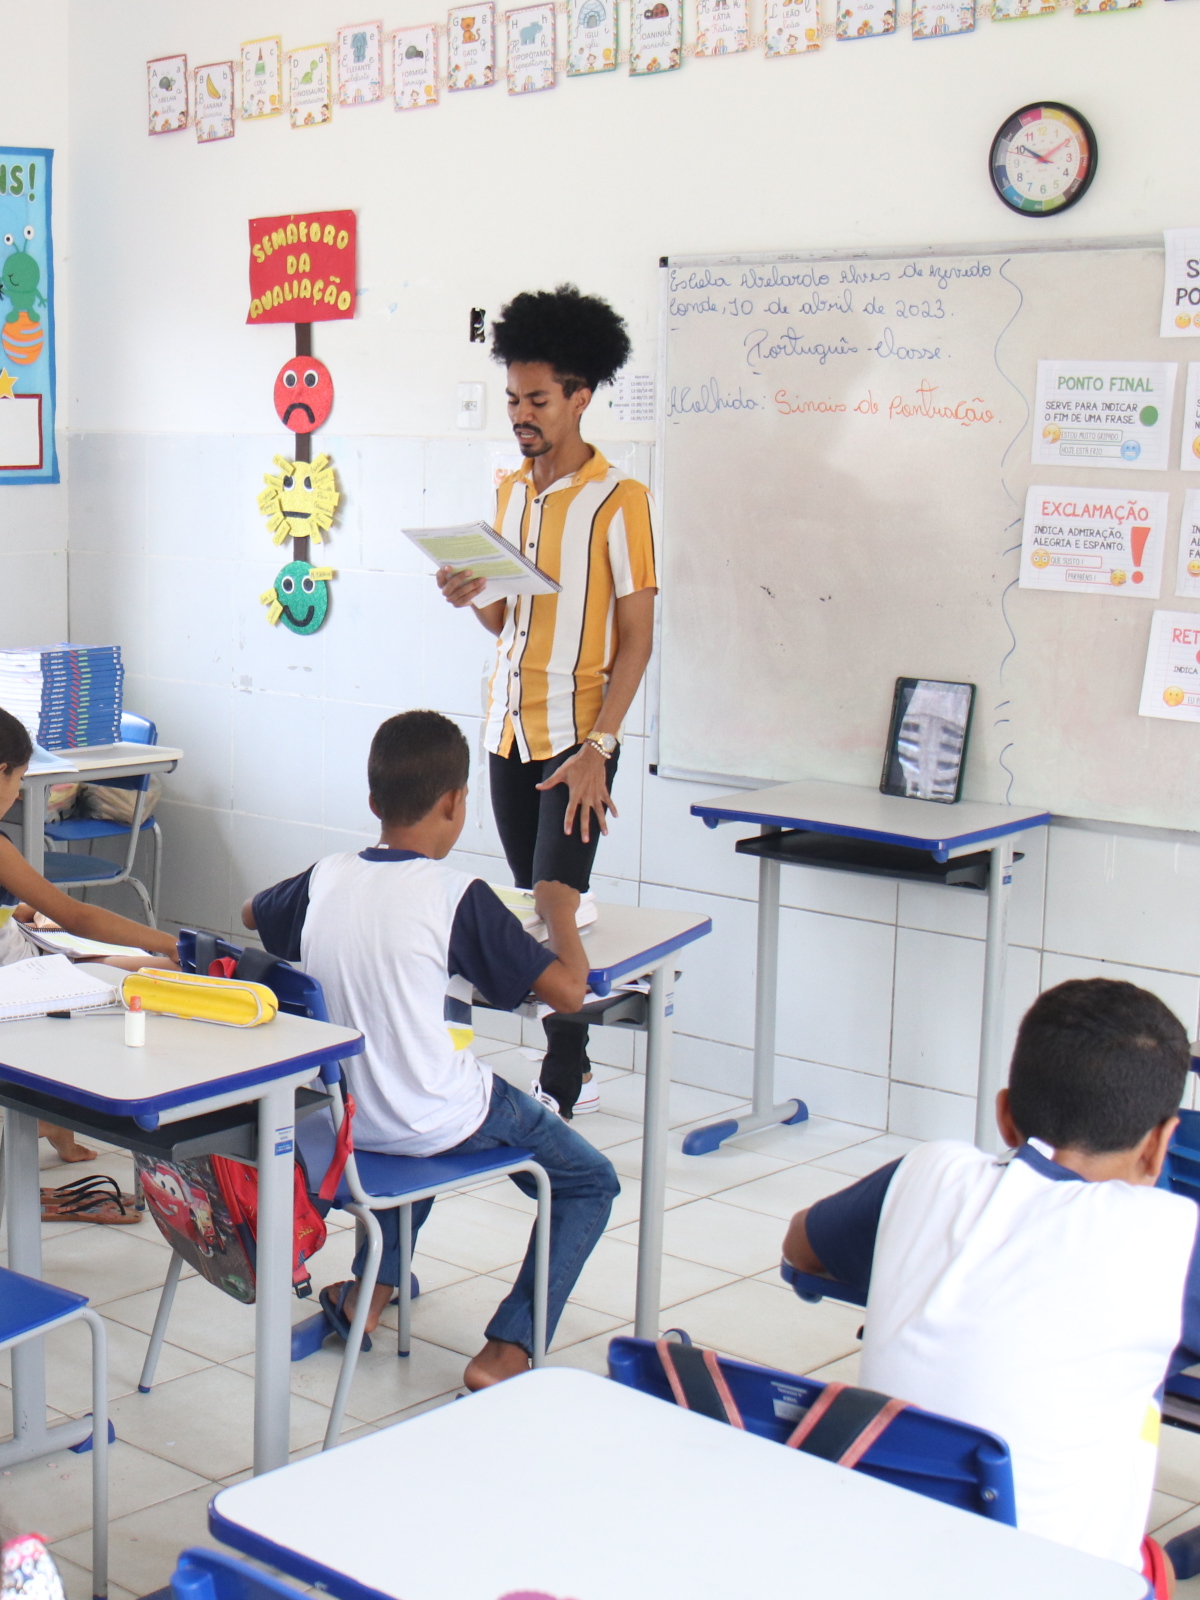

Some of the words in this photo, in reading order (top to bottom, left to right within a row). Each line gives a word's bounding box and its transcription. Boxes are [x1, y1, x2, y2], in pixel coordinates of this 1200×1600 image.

[712, 12, 731, 21] KÁTIA
[782, 9, 800, 19] LEÃO
[452, 17, 459, 27] G
[481, 15, 487, 25] g
[511, 20, 518, 30] H
[541, 14, 548, 24] h
[342, 36, 348, 45] E
[369, 33, 375, 41] e
[584, 31, 599, 39] IGLU
[639, 31, 672, 41] JOANINHA
[397, 39, 402, 49] F
[425, 33, 429, 43] f
[479, 39, 487, 51] g
[540, 34, 548, 48] h
[245, 52, 251, 60] C
[269, 48, 275, 56] c
[462, 49, 478, 57] GATO
[511, 49, 551, 61] HIPOPÓTAMO
[293, 59, 299, 69] D
[318, 53, 324, 64] d
[152, 70, 158, 78] A
[176, 66, 181, 74] a
[346, 64, 371, 74] ELEFANTE
[401, 69, 428, 78] FORMIGA
[199, 75, 204, 84] B
[222, 70, 228, 79] b
[254, 80, 267, 88] COLA
[293, 87, 326, 98] DINOSSAURO
[158, 95, 177, 104] ABELHA
[202, 101, 223, 110] BANANA
[1037, 126, 1049, 136] 12
[1054, 128, 1059, 138] 1
[1025, 132, 1034, 142] 11
[1064, 138, 1071, 148] 2
[1015, 145, 1026, 155] 10
[1013, 158, 1020, 168] 9
[1066, 153, 1073, 163] 3
[1017, 172, 1023, 182] 8
[1062, 168, 1070, 177] 4
[1026, 182, 1033, 192] 7
[1040, 184, 1047, 195] 6
[1053, 179, 1059, 190] 5
[252, 215, 349, 263] SEMÁFORO
[286, 252, 311, 275] DA
[670, 269, 731, 292] Escola
[740, 265, 830, 289] Abelardo
[898, 261, 923, 279] de
[250, 275, 351, 319] AVALIAÇÃO
[1175, 287, 1200, 306] PO
[763, 296, 790, 315] de
[799, 289, 854, 315] abril
[863, 296, 885, 315] de
[743, 326, 858, 366] Português
[1057, 376, 1104, 391] PONTO
[1109, 377, 1154, 392] FINAL
[774, 389, 847, 415] Sinais
[853, 389, 880, 415] de
[1045, 401, 1072, 410] SERVE
[1074, 402, 1098, 411] PARA
[1101, 402, 1138, 412] INDICAR
[1044, 413, 1050, 421] O
[1053, 413, 1068, 422] FIM
[1071, 414, 1081, 422] DE
[1084, 414, 1102, 423] UMA
[1061, 431, 1078, 439] ESTOU
[1079, 432, 1096, 440] MUITO
[1062, 447, 1075, 455] HOJE
[1076, 446, 1089, 455] ESTÁ
[1041, 500, 1149, 525] EXCLAMAÇÃO
[1034, 526, 1064, 535] INDICA
[1033, 537, 1072, 548] ALEGRIA
[1075, 540, 1080, 548] E
[1083, 541, 1125, 551] ESPANTO.
[1051, 557, 1062, 565] QUE
[1063, 558, 1080, 566] SUSTO
[1173, 665, 1198, 675] INDICA
[1187, 696, 1195, 704] EU
